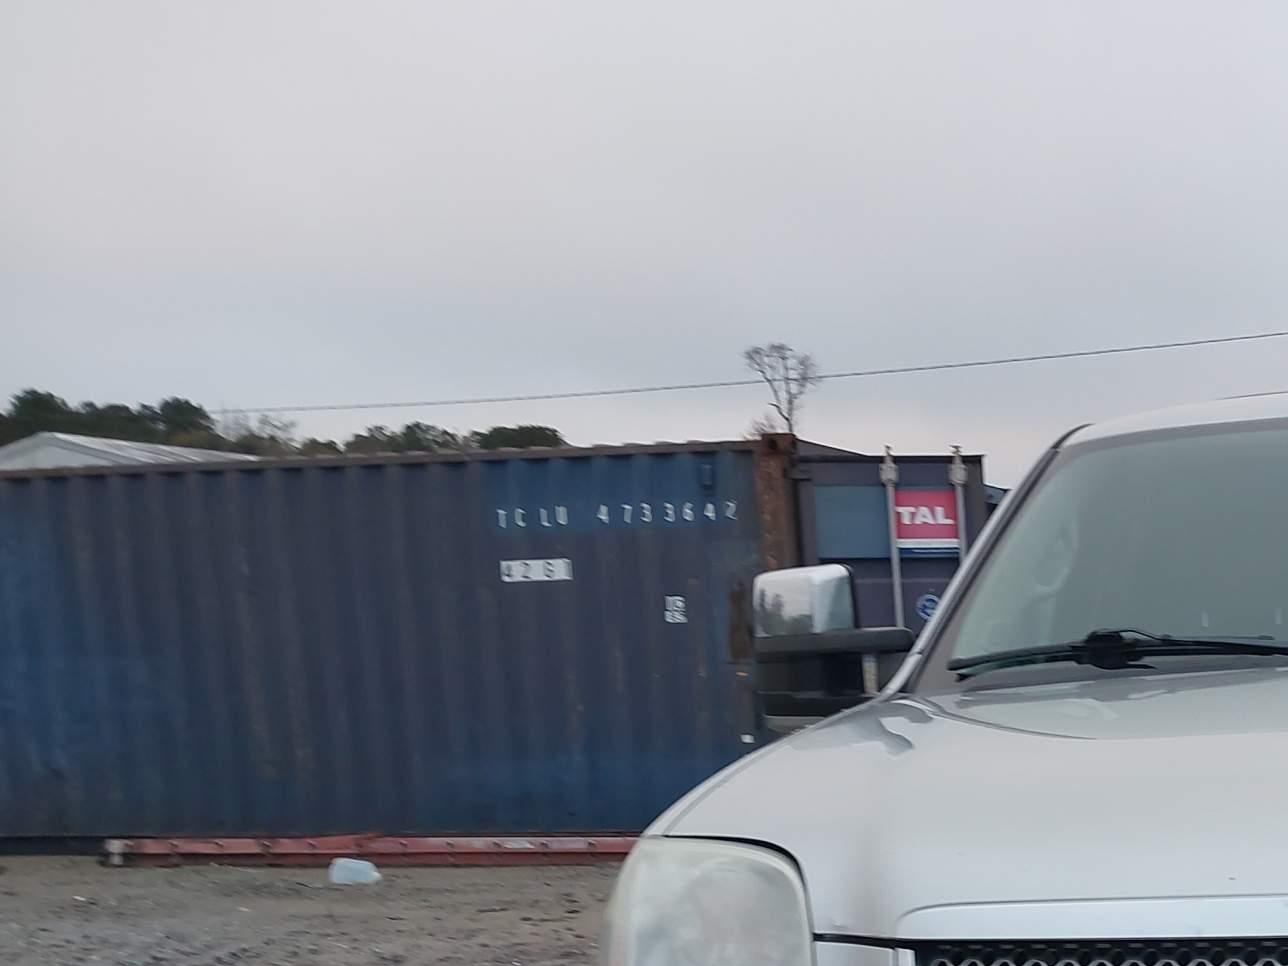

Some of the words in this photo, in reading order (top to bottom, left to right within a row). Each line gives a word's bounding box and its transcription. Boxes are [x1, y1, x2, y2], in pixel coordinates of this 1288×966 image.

[496, 505, 568, 529] TCLU
[597, 500, 738, 523] 4733642
[896, 506, 955, 525] TAL
